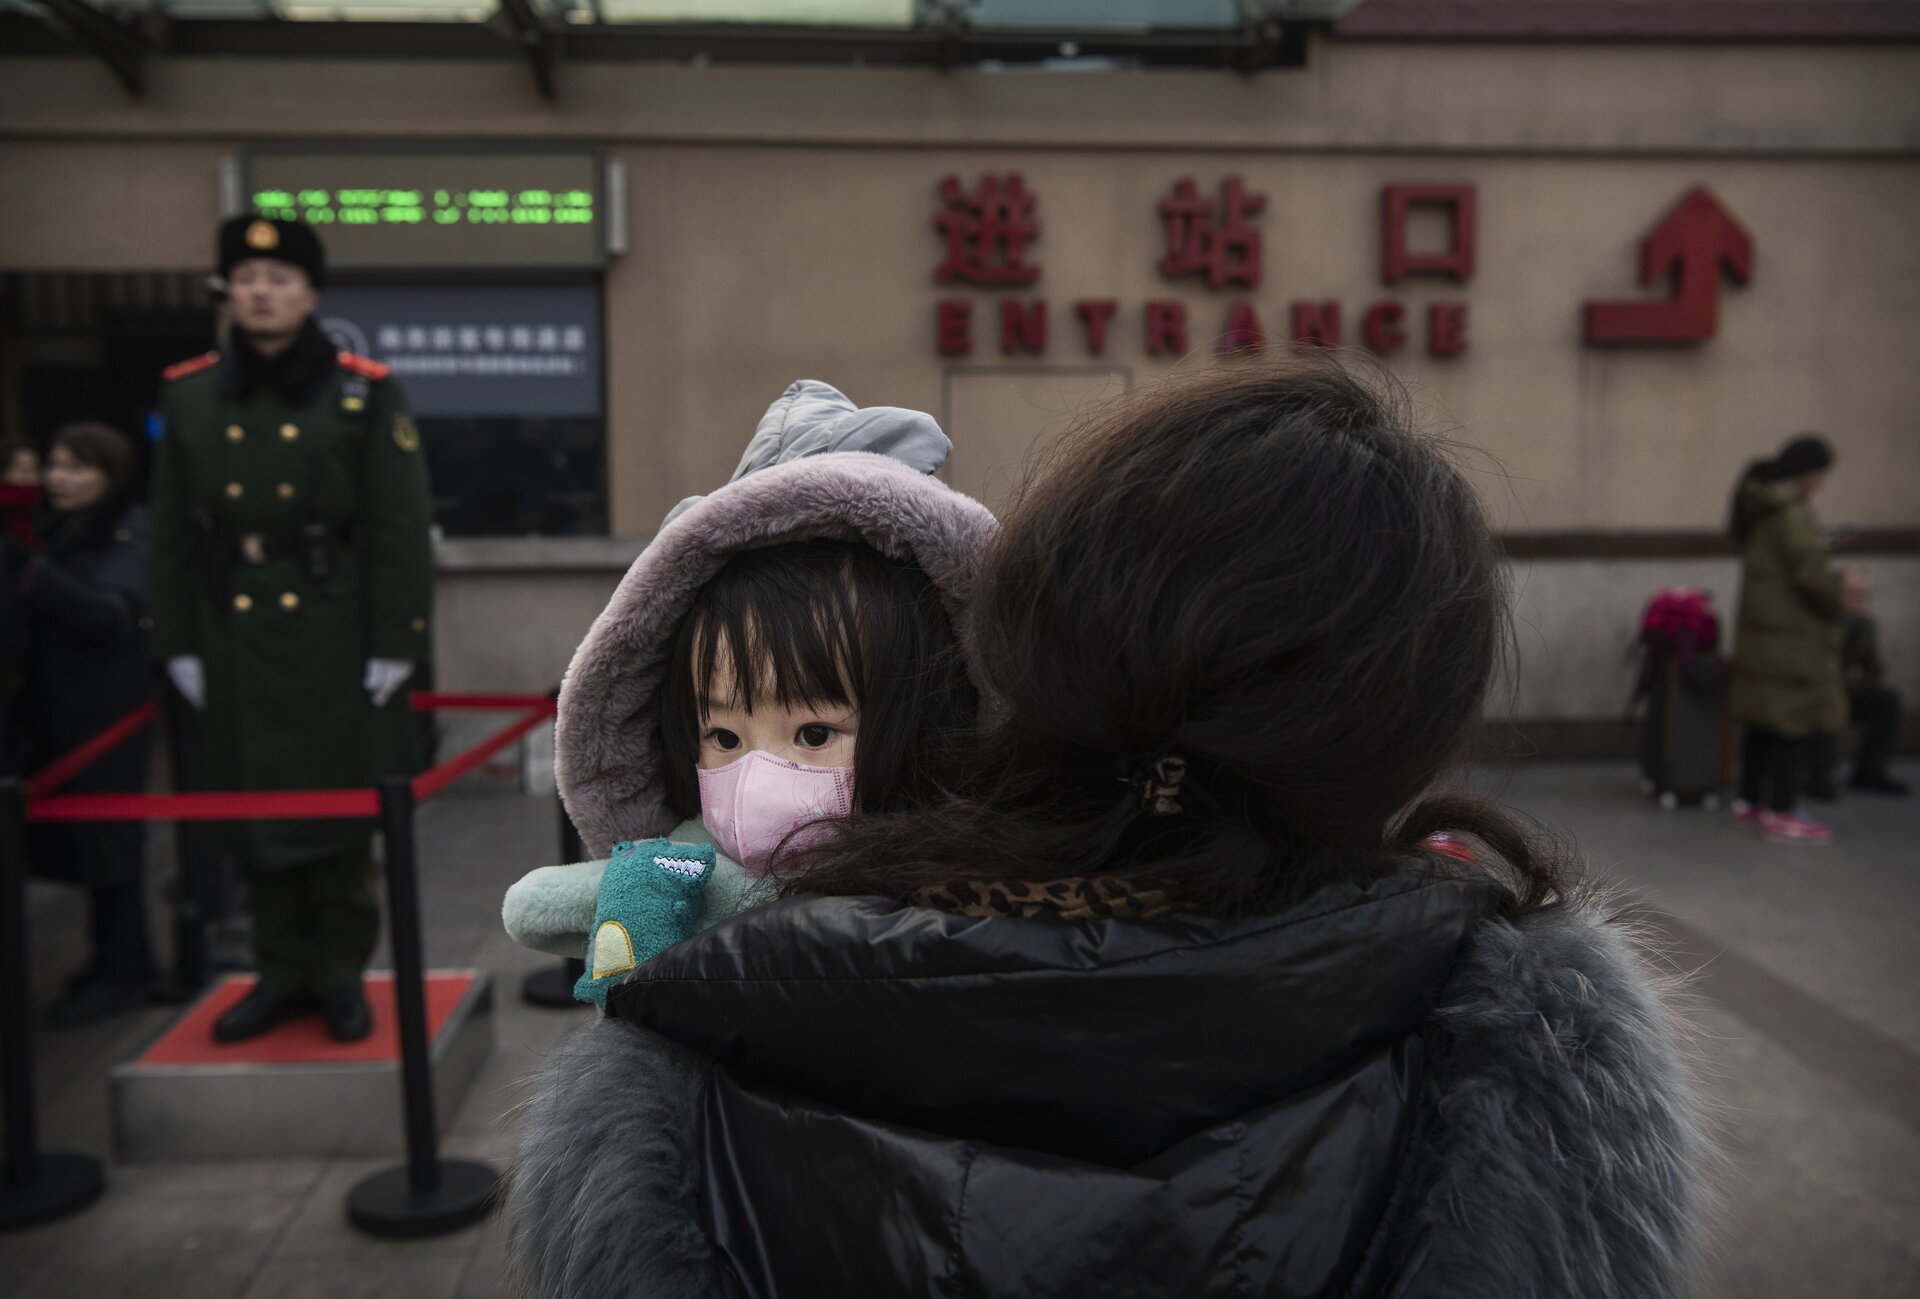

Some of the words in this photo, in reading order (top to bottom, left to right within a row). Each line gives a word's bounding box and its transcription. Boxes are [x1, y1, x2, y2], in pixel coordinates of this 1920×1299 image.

[935, 172, 1478, 287] 进站口
[936, 299, 1469, 356] ENTRANCE
